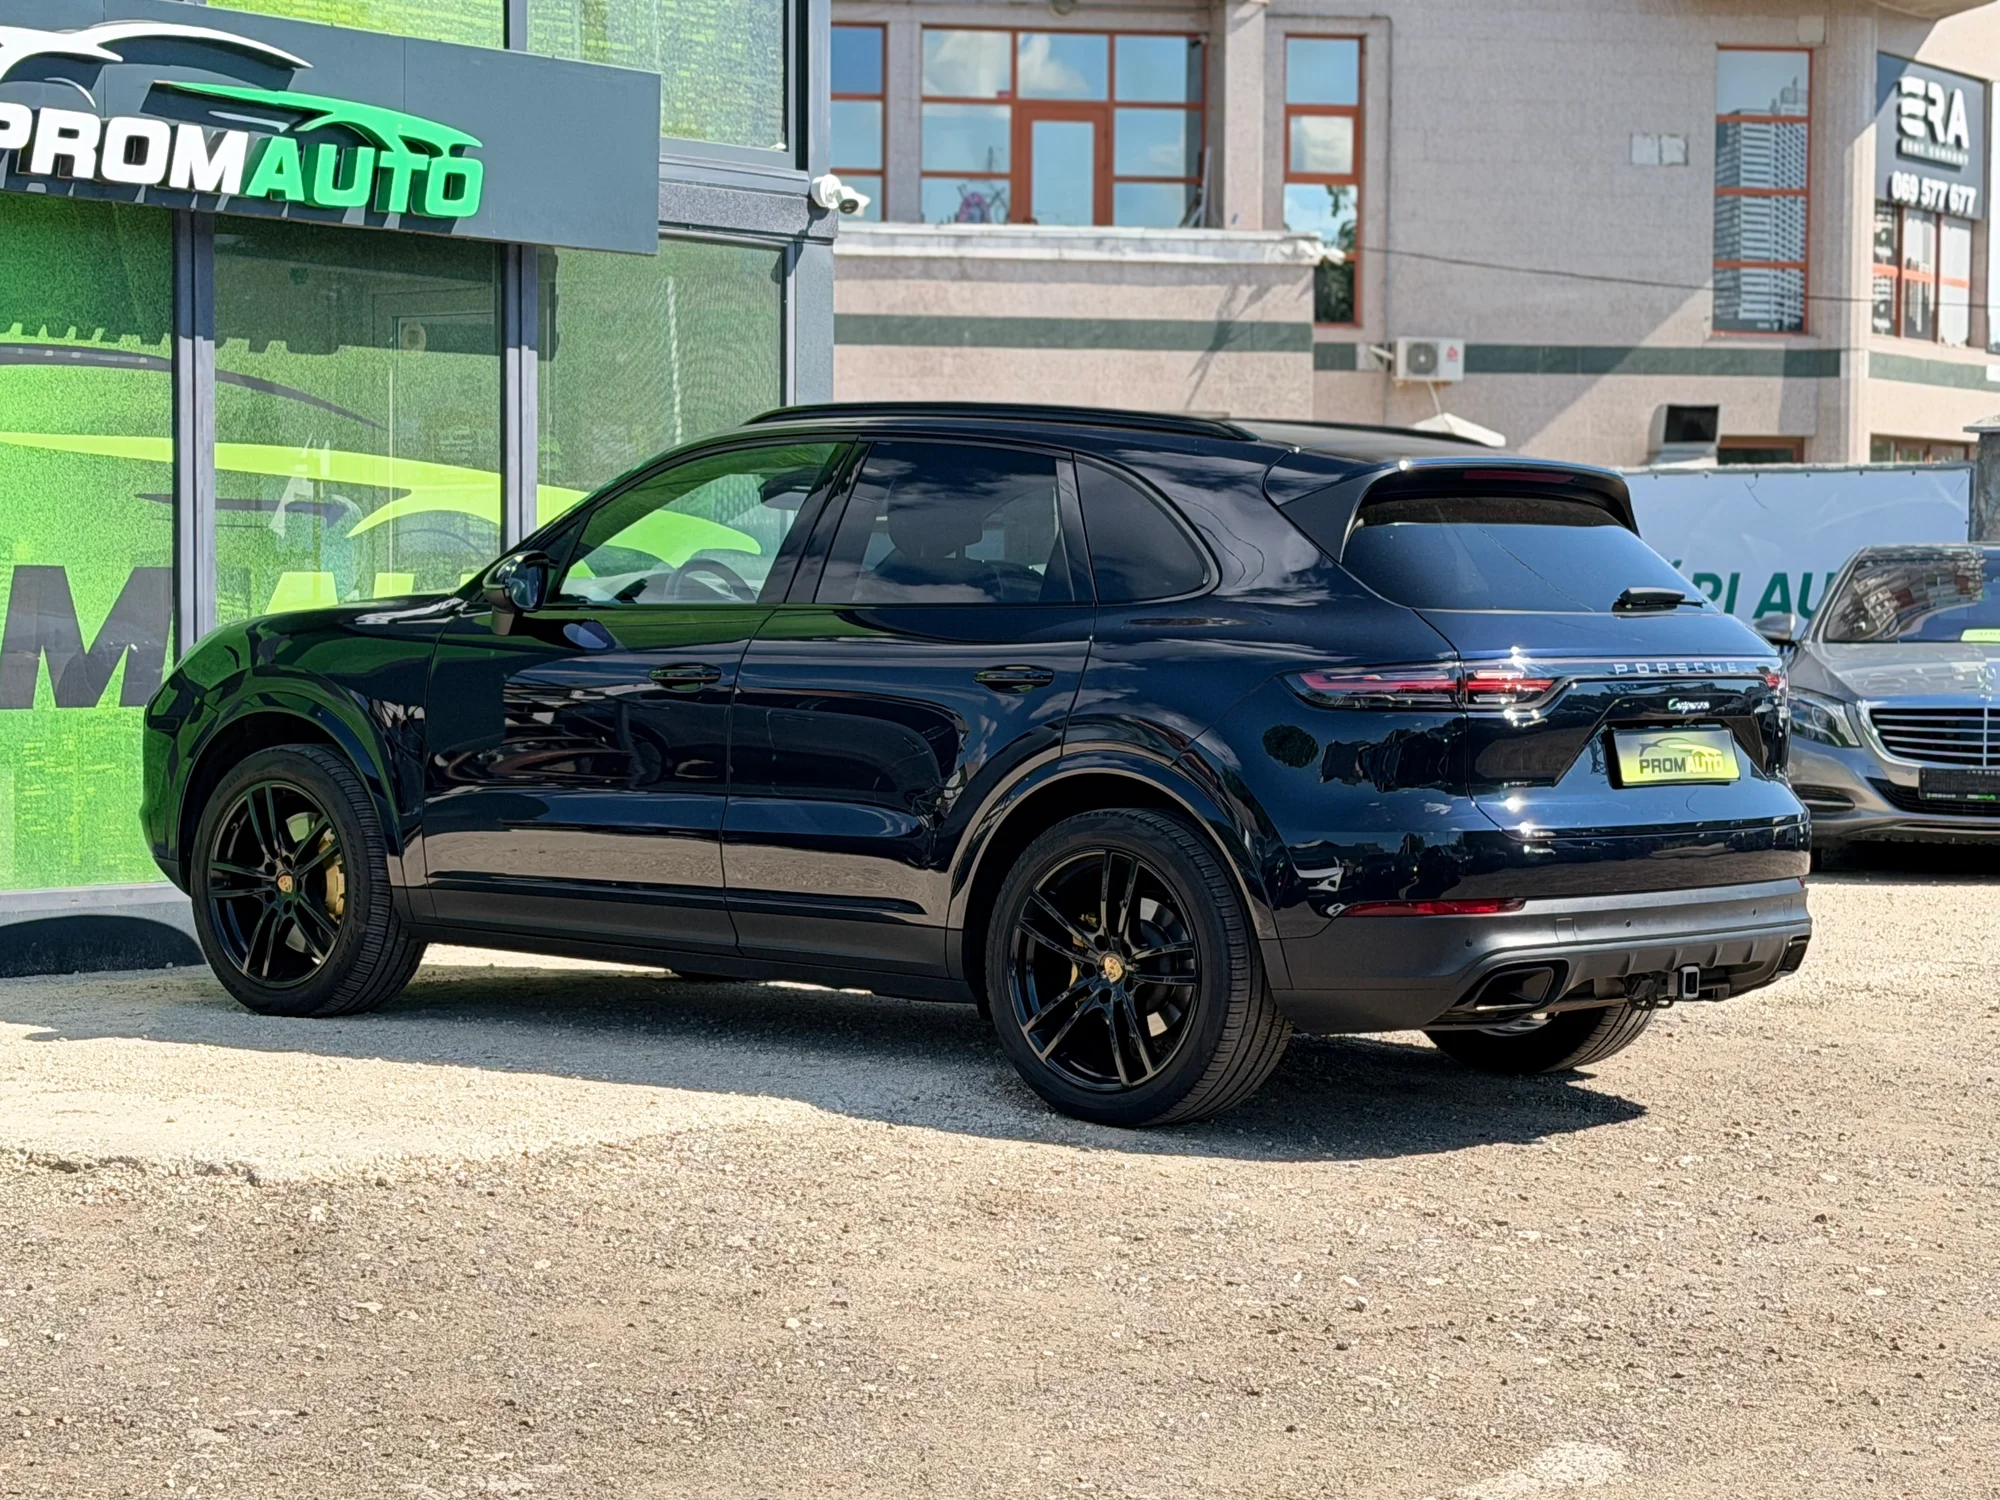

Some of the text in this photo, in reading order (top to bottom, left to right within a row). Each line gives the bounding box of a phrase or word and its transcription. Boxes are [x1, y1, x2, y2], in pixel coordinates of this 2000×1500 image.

[1900, 76, 1970, 149] ERA
[1891, 170, 1977, 215] 069 577 677
[1613, 663, 1740, 675] PORSCHE
[1639, 753, 1725, 775] PROMAUTO
